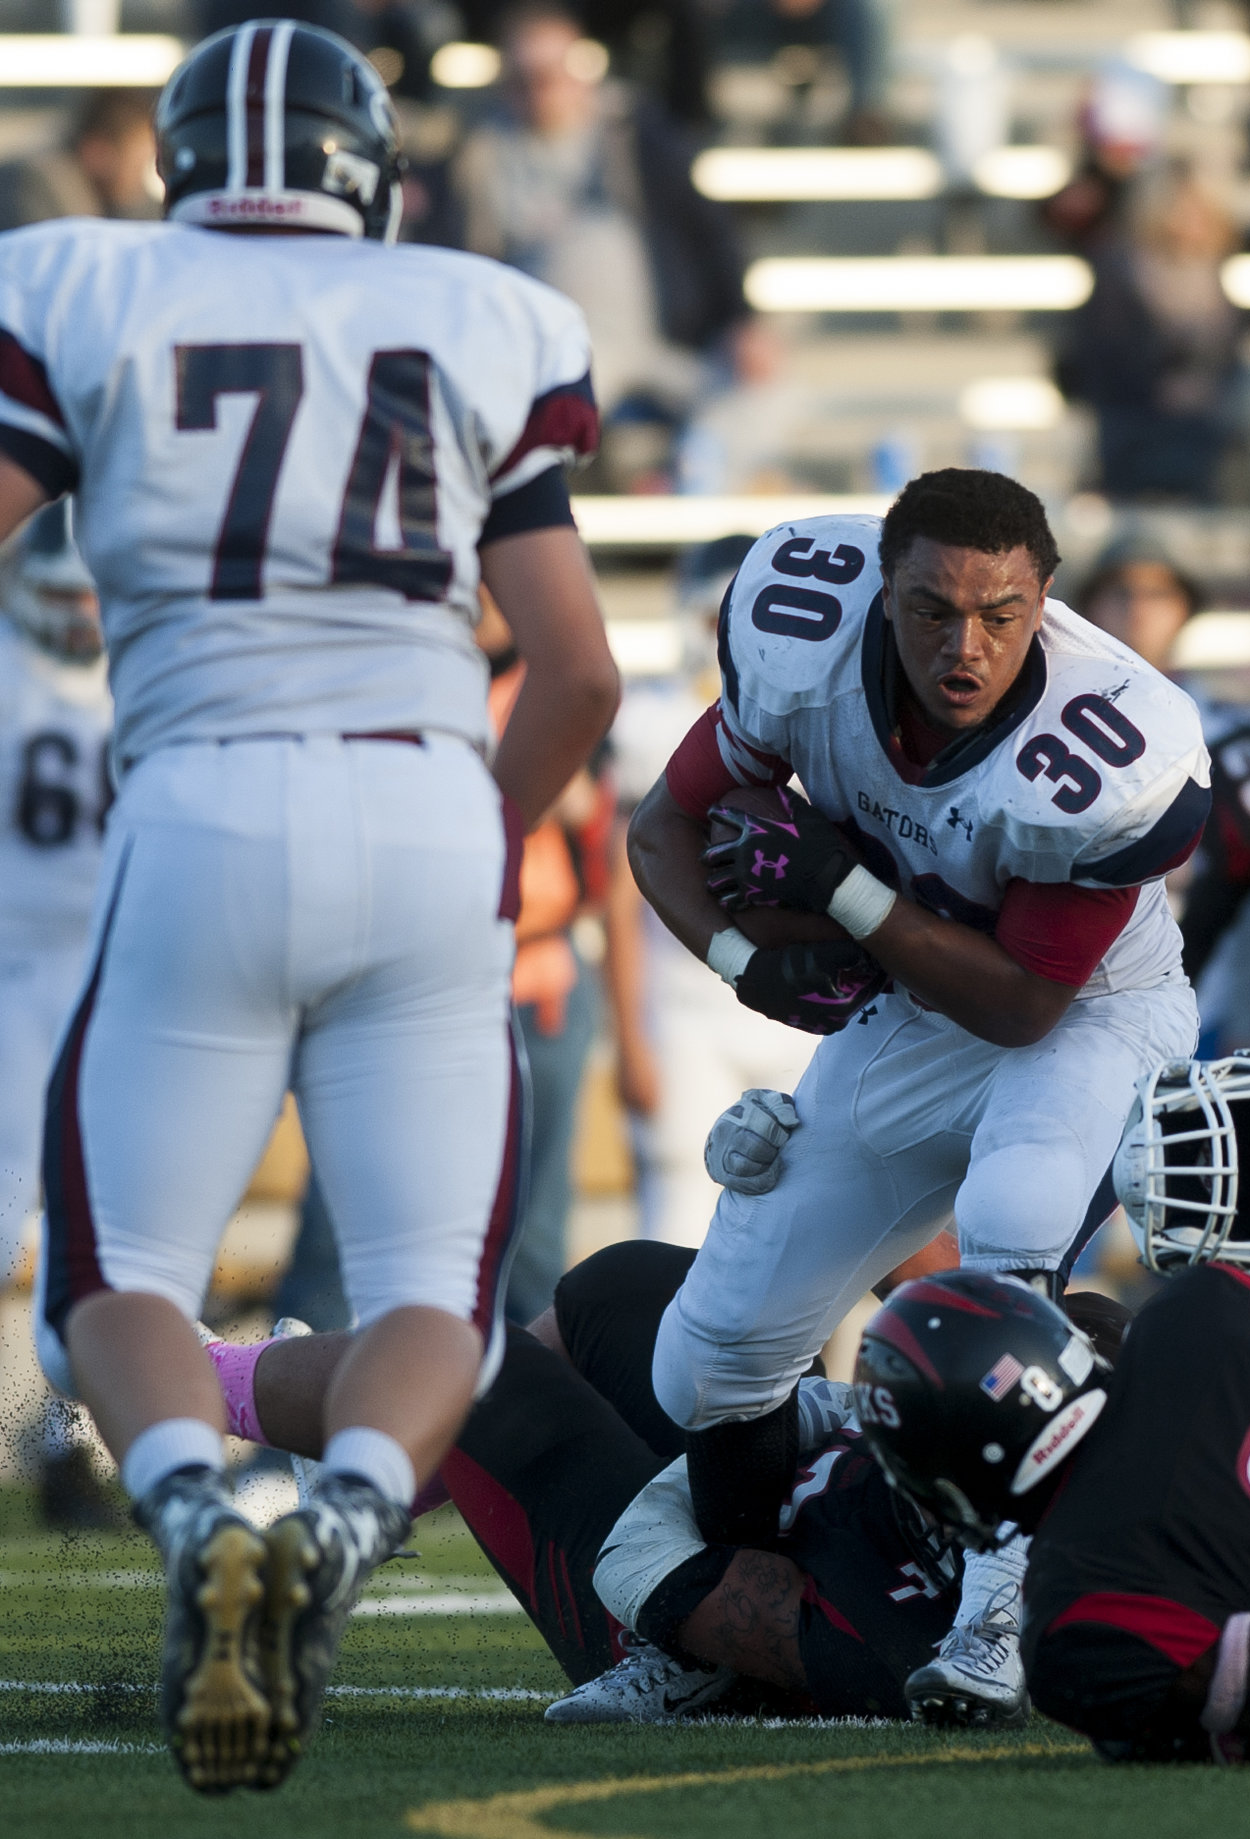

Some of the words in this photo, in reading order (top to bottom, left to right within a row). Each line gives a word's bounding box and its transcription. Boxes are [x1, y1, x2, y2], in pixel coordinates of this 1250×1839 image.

[173, 342, 455, 605] 74
[751, 536, 867, 642] 30
[1016, 693, 1147, 815] 30
[857, 790, 938, 857] GATORS
[1032, 1405, 1086, 1465] Riddell
